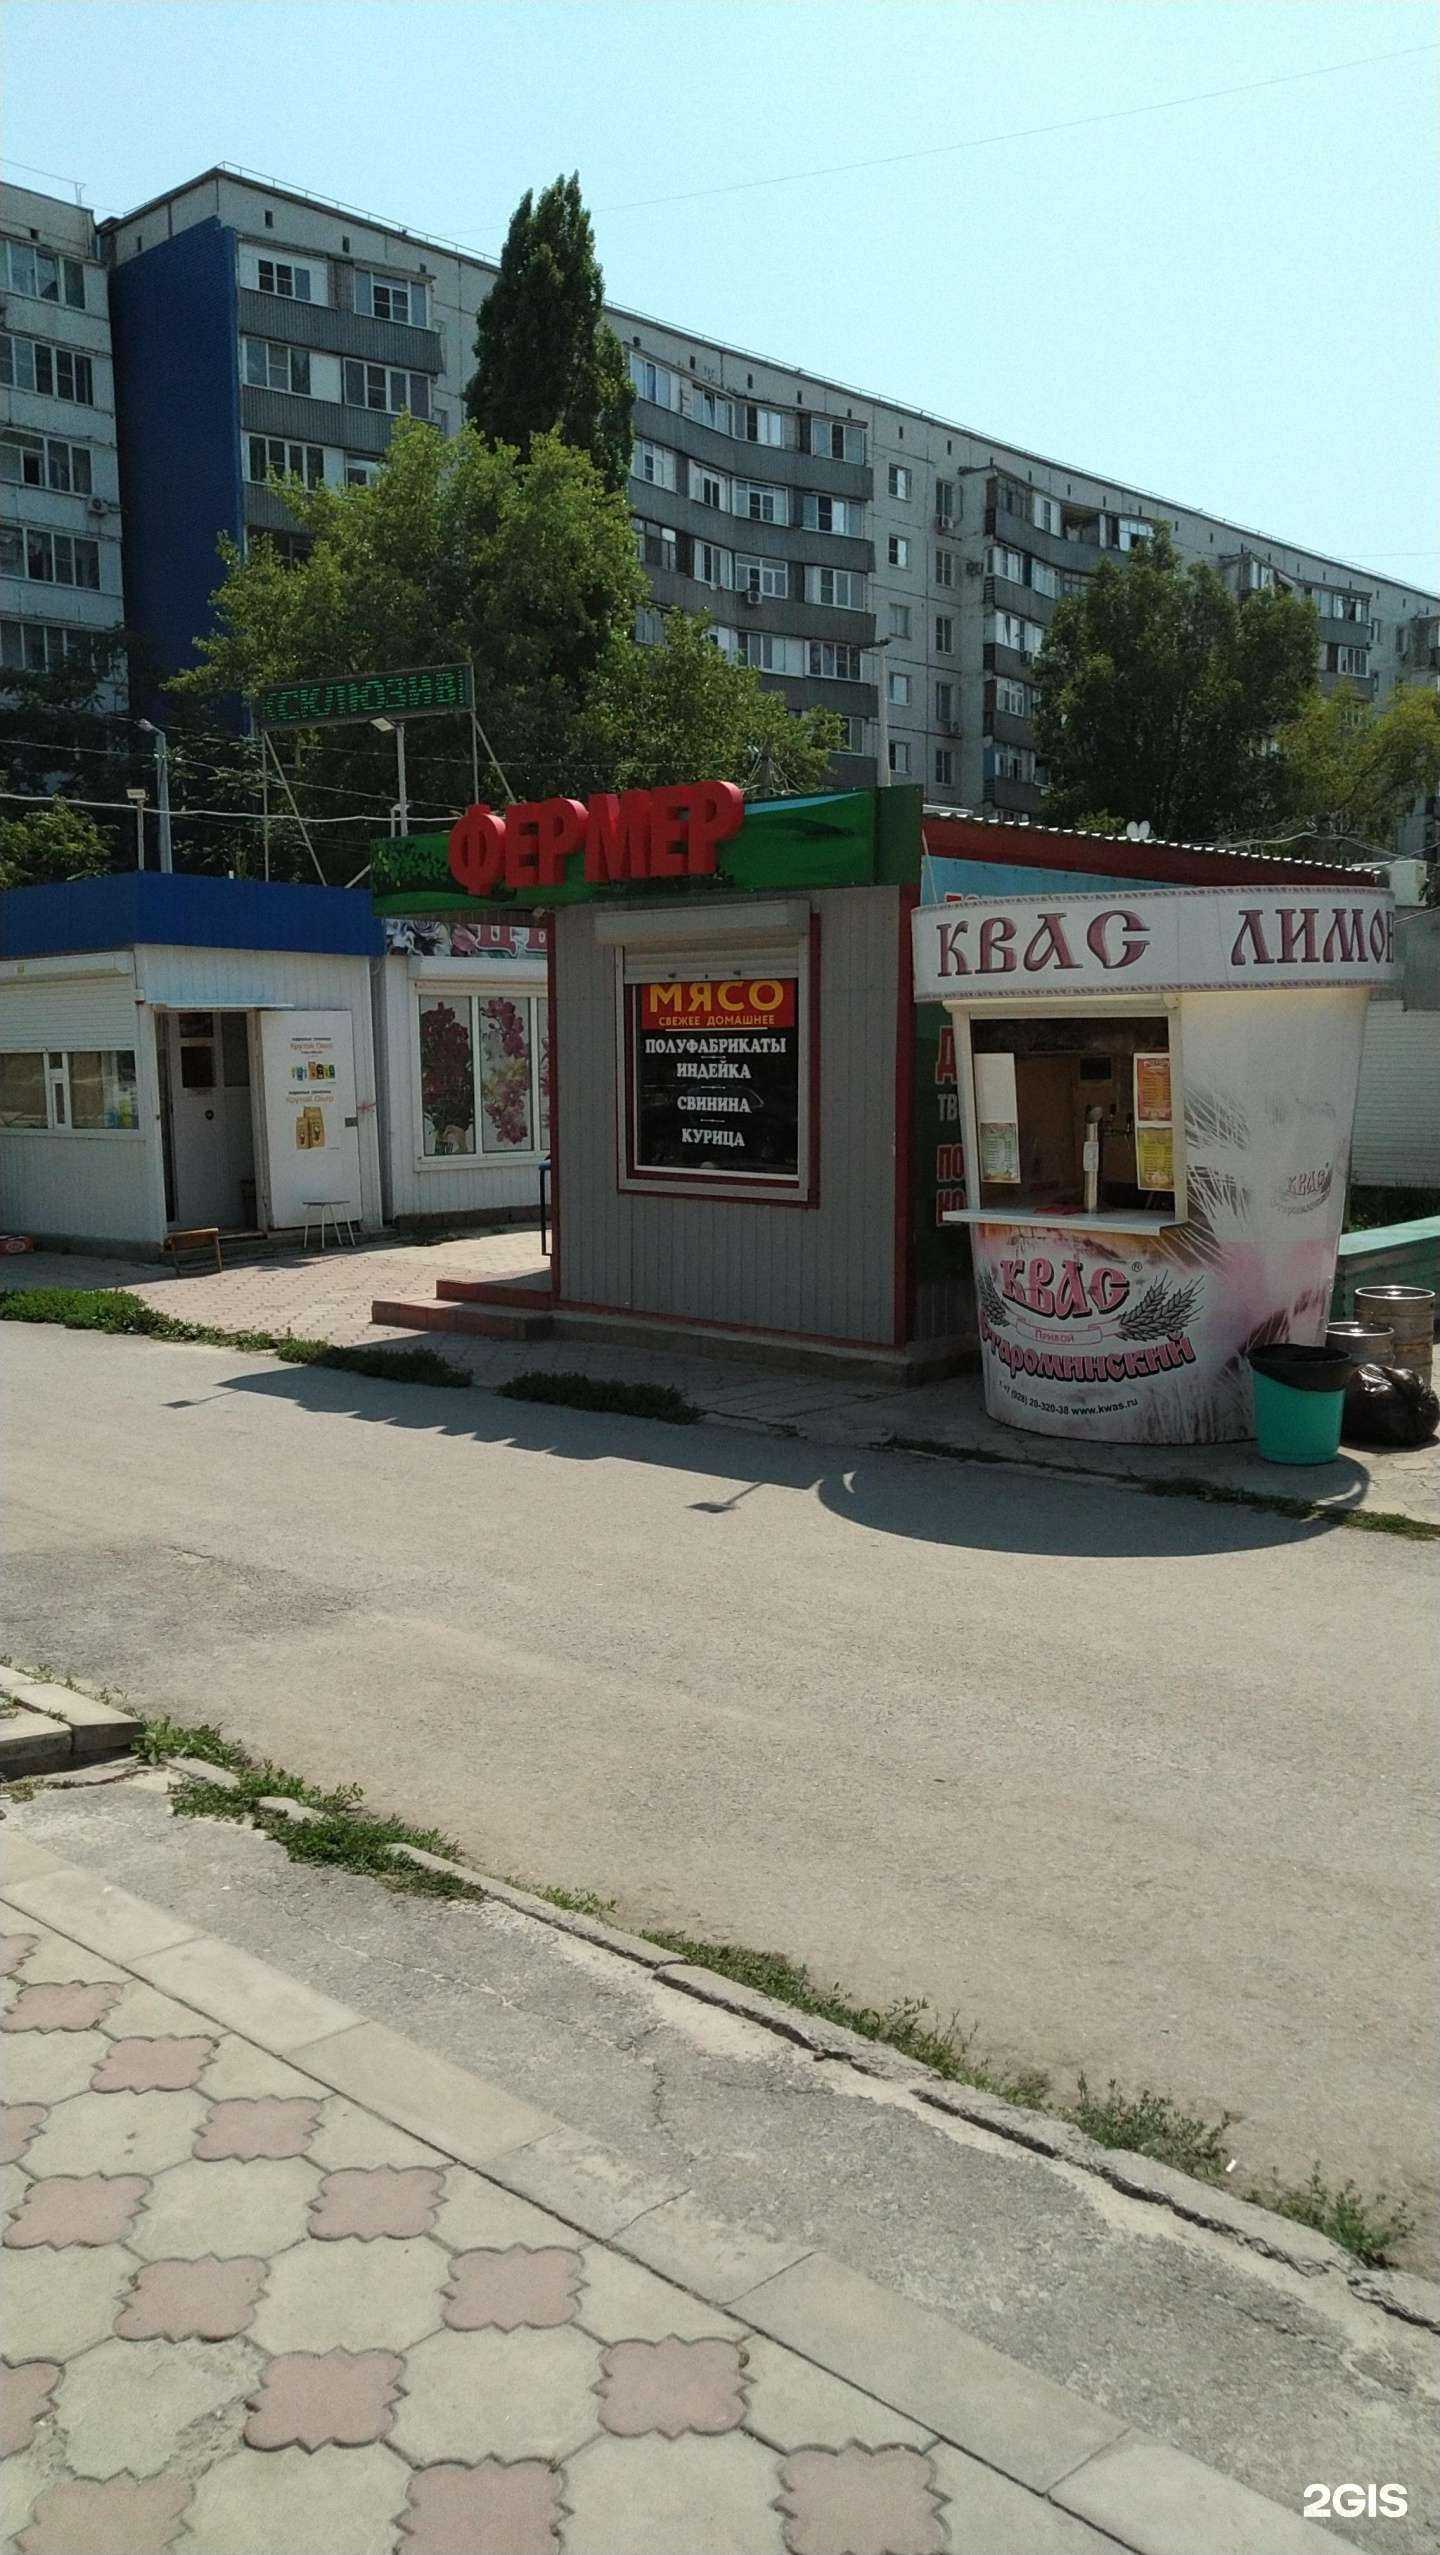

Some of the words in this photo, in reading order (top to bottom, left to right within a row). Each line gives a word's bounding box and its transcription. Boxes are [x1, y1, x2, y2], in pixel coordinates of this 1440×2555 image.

[449, 780, 745, 896] ФЕРМЕР
[936, 909, 1150, 977] КВАС
[650, 981, 784, 1012] МЯСО
[659, 1016, 700, 1026] СВЕЖЕЕ
[707, 1014, 775, 1026] ДОМАШНЕЕ
[645, 1038, 786, 1054] ПОЛУФАБРИКАТЫ
[676, 1060, 752, 1080] ИНДЕЙКА
[677, 1096, 752, 1113] СВИНИНА
[682, 1128, 745, 1147] КУРИЦА
[1000, 1258, 1130, 1320] КВАС
[1071, 1398, 1138, 1415] www.kwas.ru
